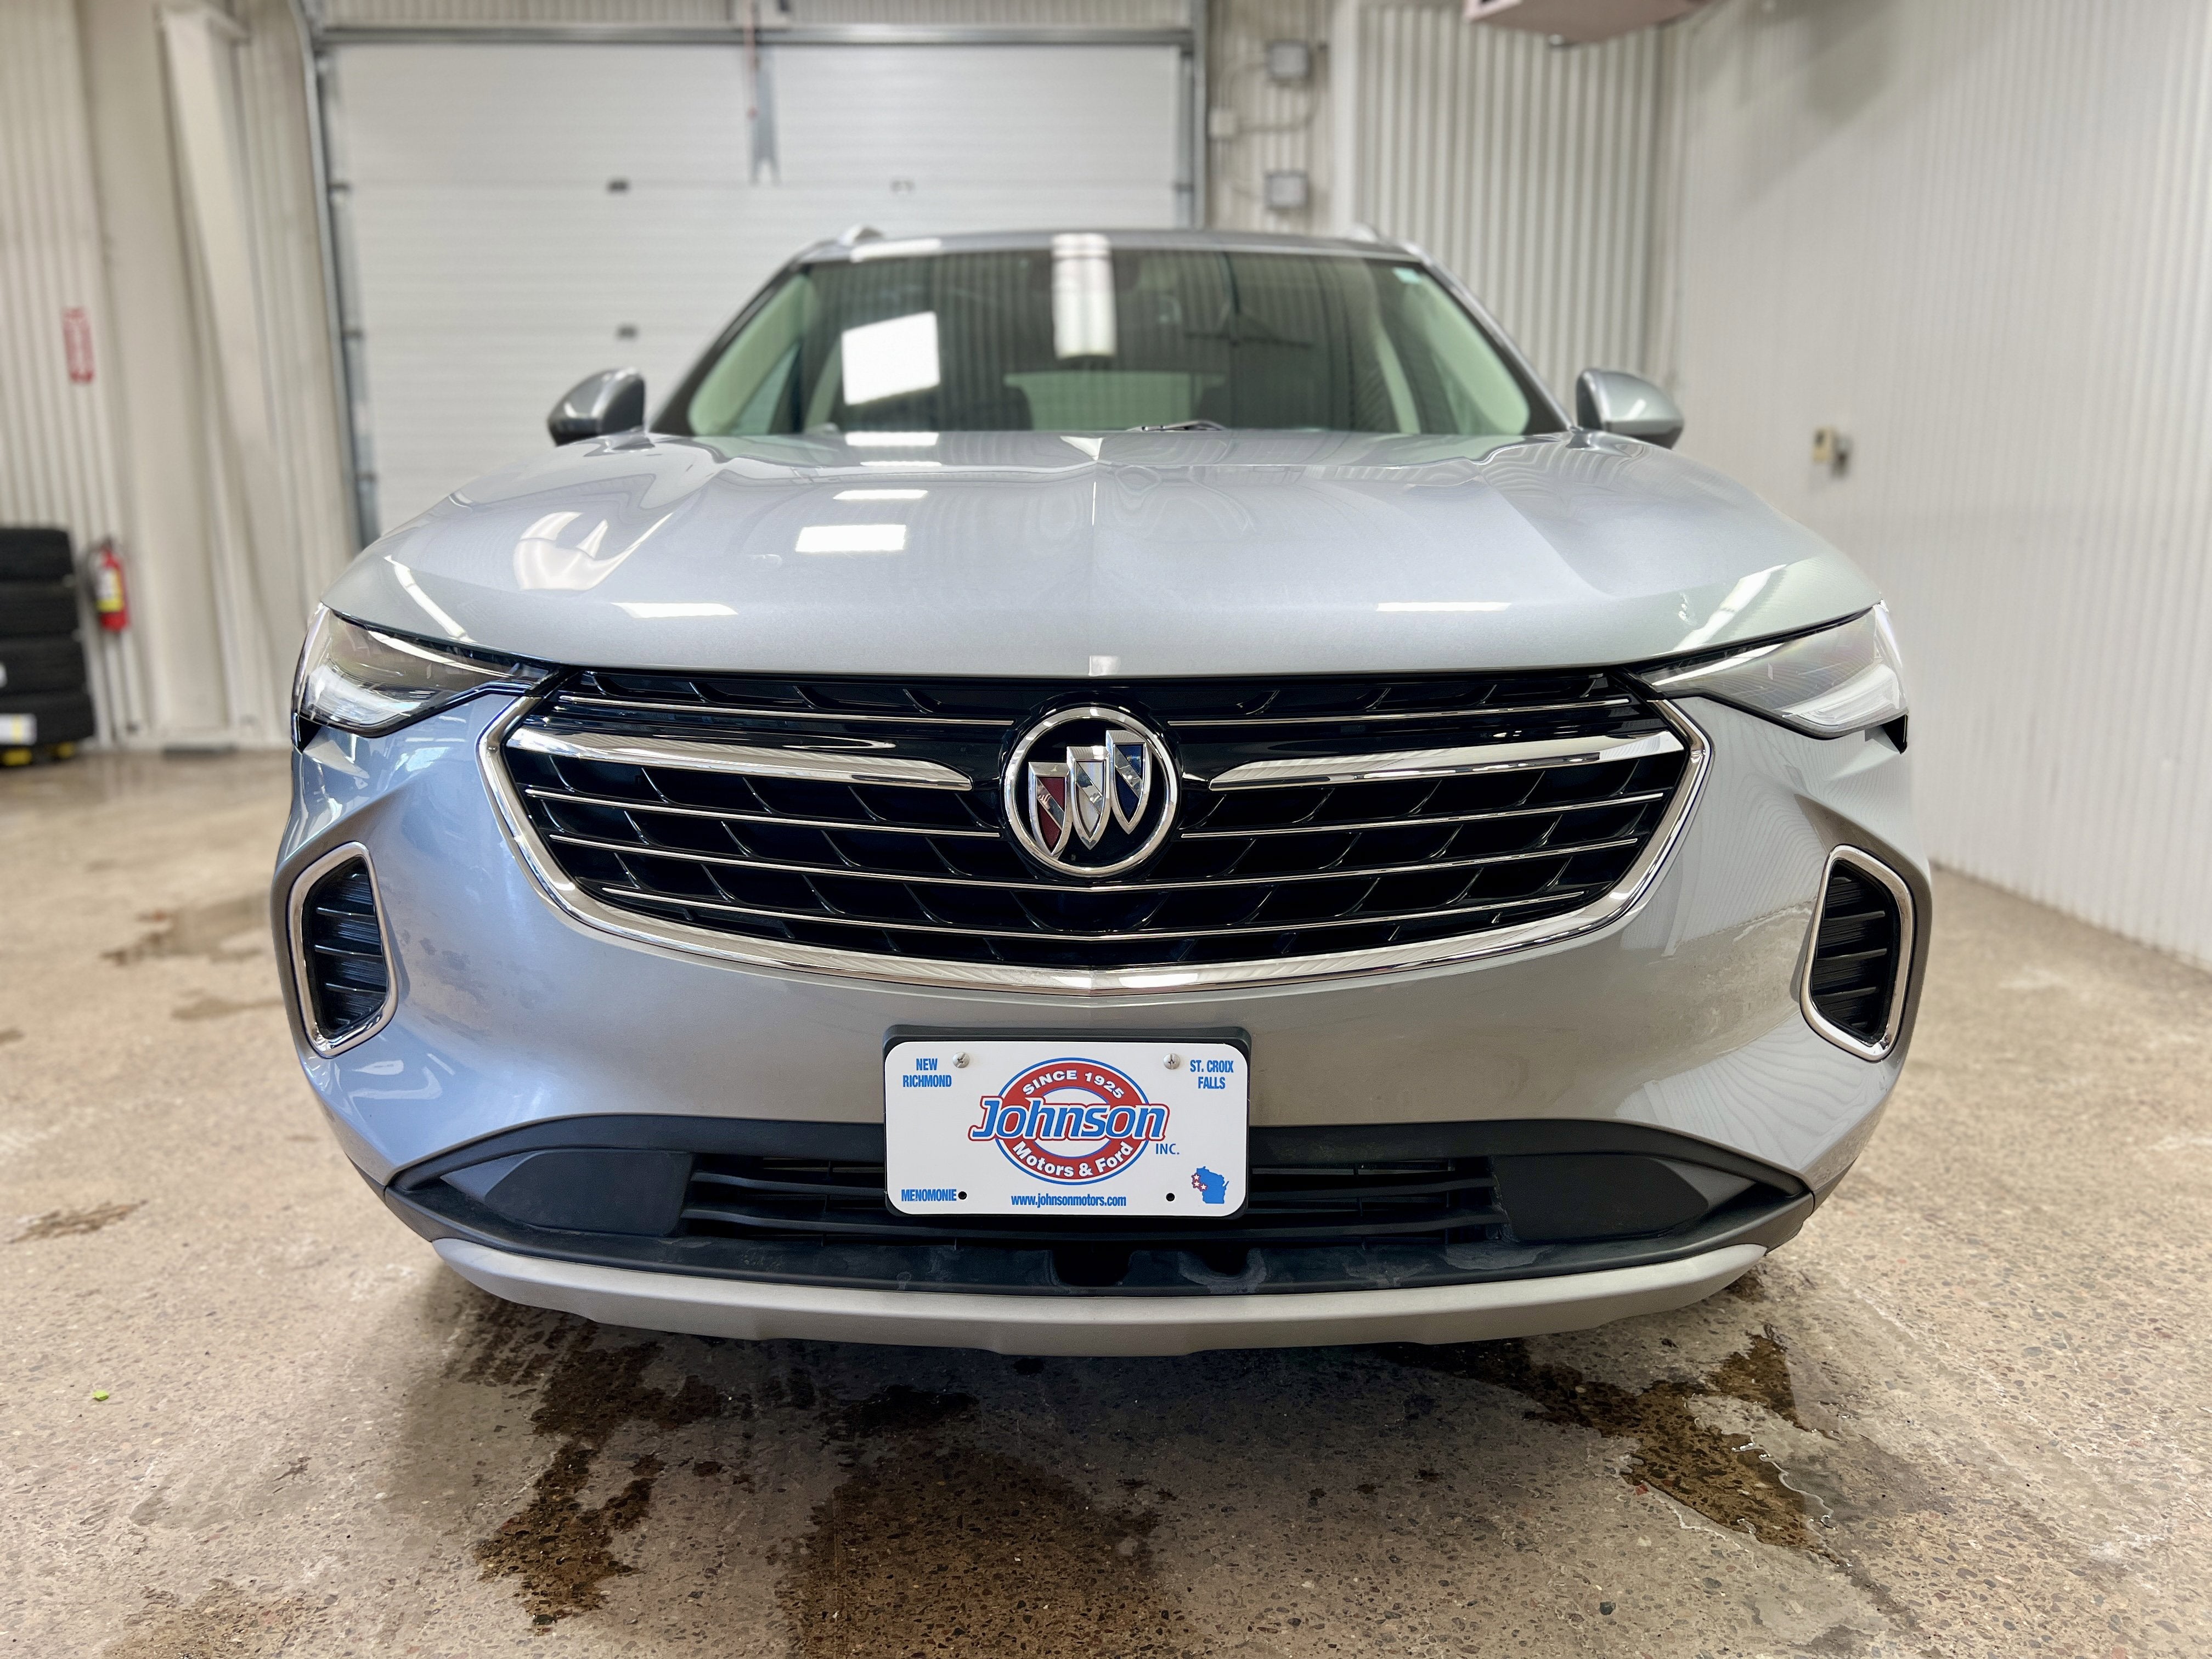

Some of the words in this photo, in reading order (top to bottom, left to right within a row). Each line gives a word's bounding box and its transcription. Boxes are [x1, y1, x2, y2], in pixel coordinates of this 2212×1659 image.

[916, 1058, 938, 1071] NEW
[1190, 1060, 1204, 1072] ST.
[1207, 1060, 1234, 1073] CROIX
[902, 1075, 952, 1088] RICHMOND
[1022, 1070, 1077, 1096] SINCE
[1085, 1072, 1124, 1099] 1925
[1198, 1077, 1226, 1089] FALLS
[969, 1097, 1170, 1141] Johnson
[1155, 1143, 1180, 1155] INC.
[1013, 1142, 1074, 1177] Motors
[1079, 1163, 1093, 1177] &
[1096, 1142, 1133, 1172] Ford
[901, 1189, 957, 1201] MENOMONIE
[1011, 1194, 1126, 1207] www.johnsonmotors.com
